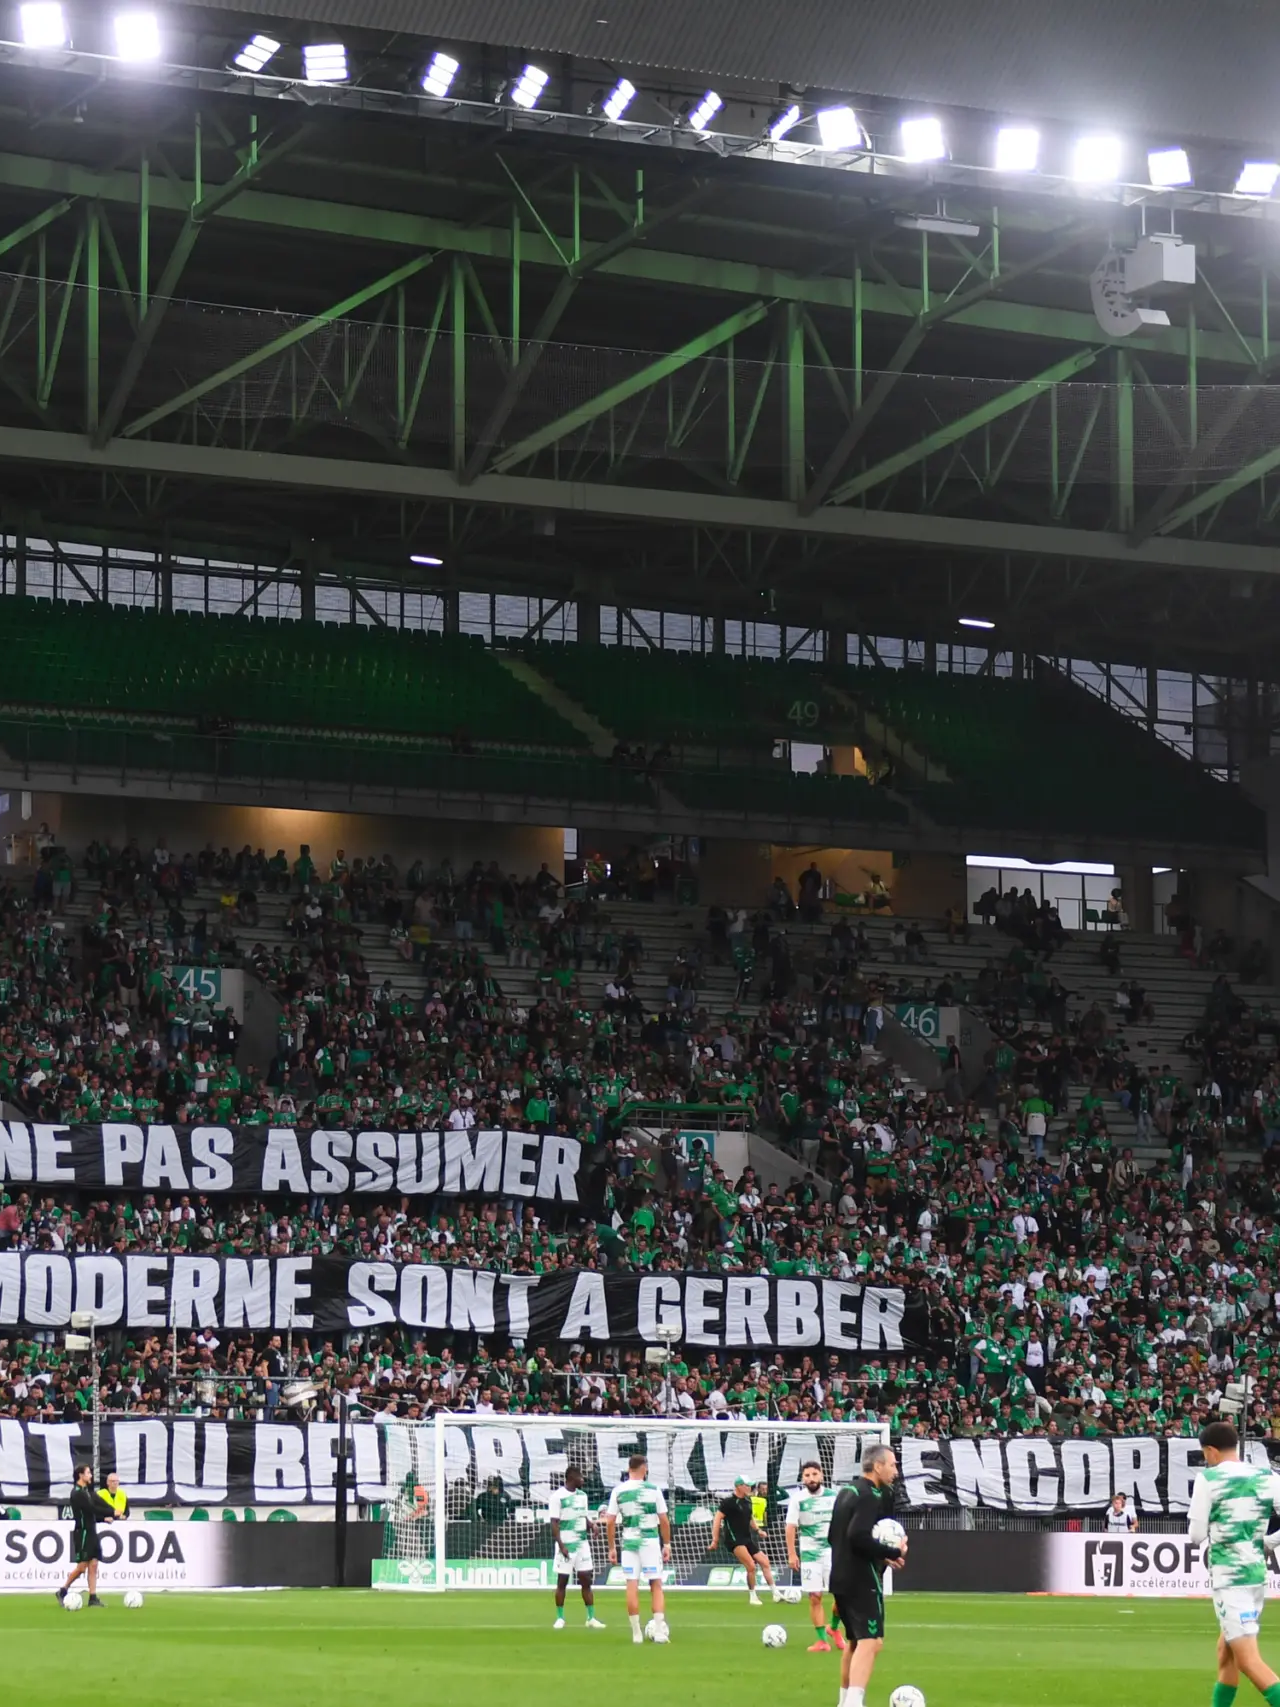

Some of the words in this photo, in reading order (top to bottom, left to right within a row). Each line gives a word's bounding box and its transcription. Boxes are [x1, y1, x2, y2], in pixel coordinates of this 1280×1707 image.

[787, 701, 820, 727] 49
[178, 968, 217, 1001] 45
[900, 1006, 936, 1037] 46
[104, 1124, 234, 1192] PAS
[261, 1128, 584, 1201] ASSUMER
[347, 1262, 540, 1345] SONT
[559, 1271, 611, 1340] A
[637, 1276, 906, 1351] GERBER
[114, 1419, 230, 1502] DU
[5, 1529, 186, 1564] SOODA
[113, 1566, 187, 1580] convivialité
[1130, 1576, 1200, 1588] accélérateur
